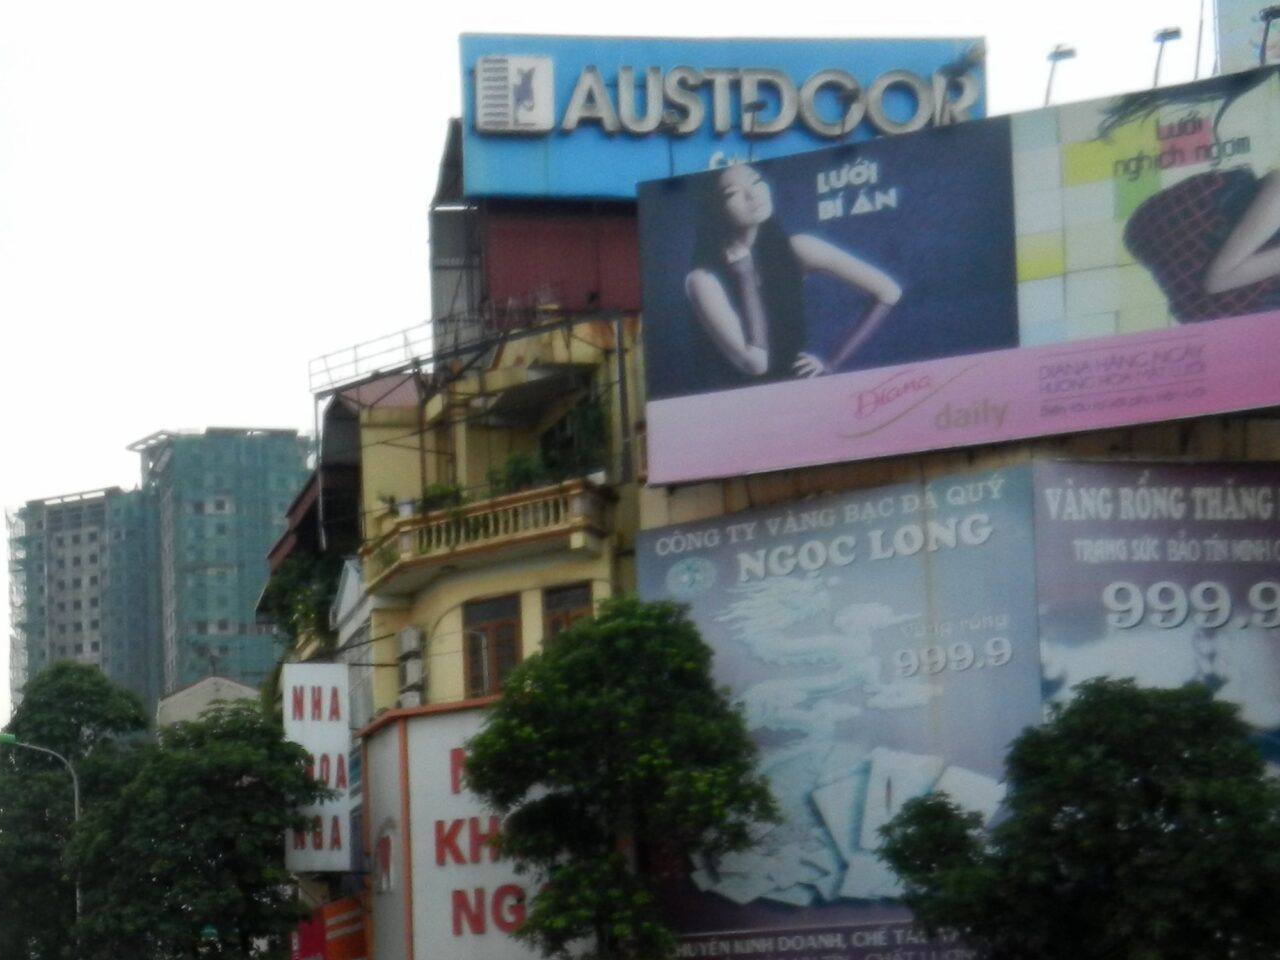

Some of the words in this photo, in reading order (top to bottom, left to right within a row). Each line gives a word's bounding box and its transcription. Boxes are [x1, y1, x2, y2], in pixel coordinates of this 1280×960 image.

[561, 64, 980, 138] AUSTDOOR
[934, 397, 1010, 431] daily
[655, 528, 721, 557] CÔNG
[726, 521, 758, 545] TY
[765, 509, 837, 537] VÀNG
[844, 496, 895, 525] BẠC
[946, 473, 1006, 506] QUÝ
[1045, 477, 1115, 521] VÀNG
[736, 534, 856, 583] NGỌC
[869, 512, 994, 562] LONG
[1102, 581, 1280, 630] 999.9
[896, 636, 1014, 679] 999.9
[434, 815, 504, 866] KH
[452, 882, 532, 937] NG
